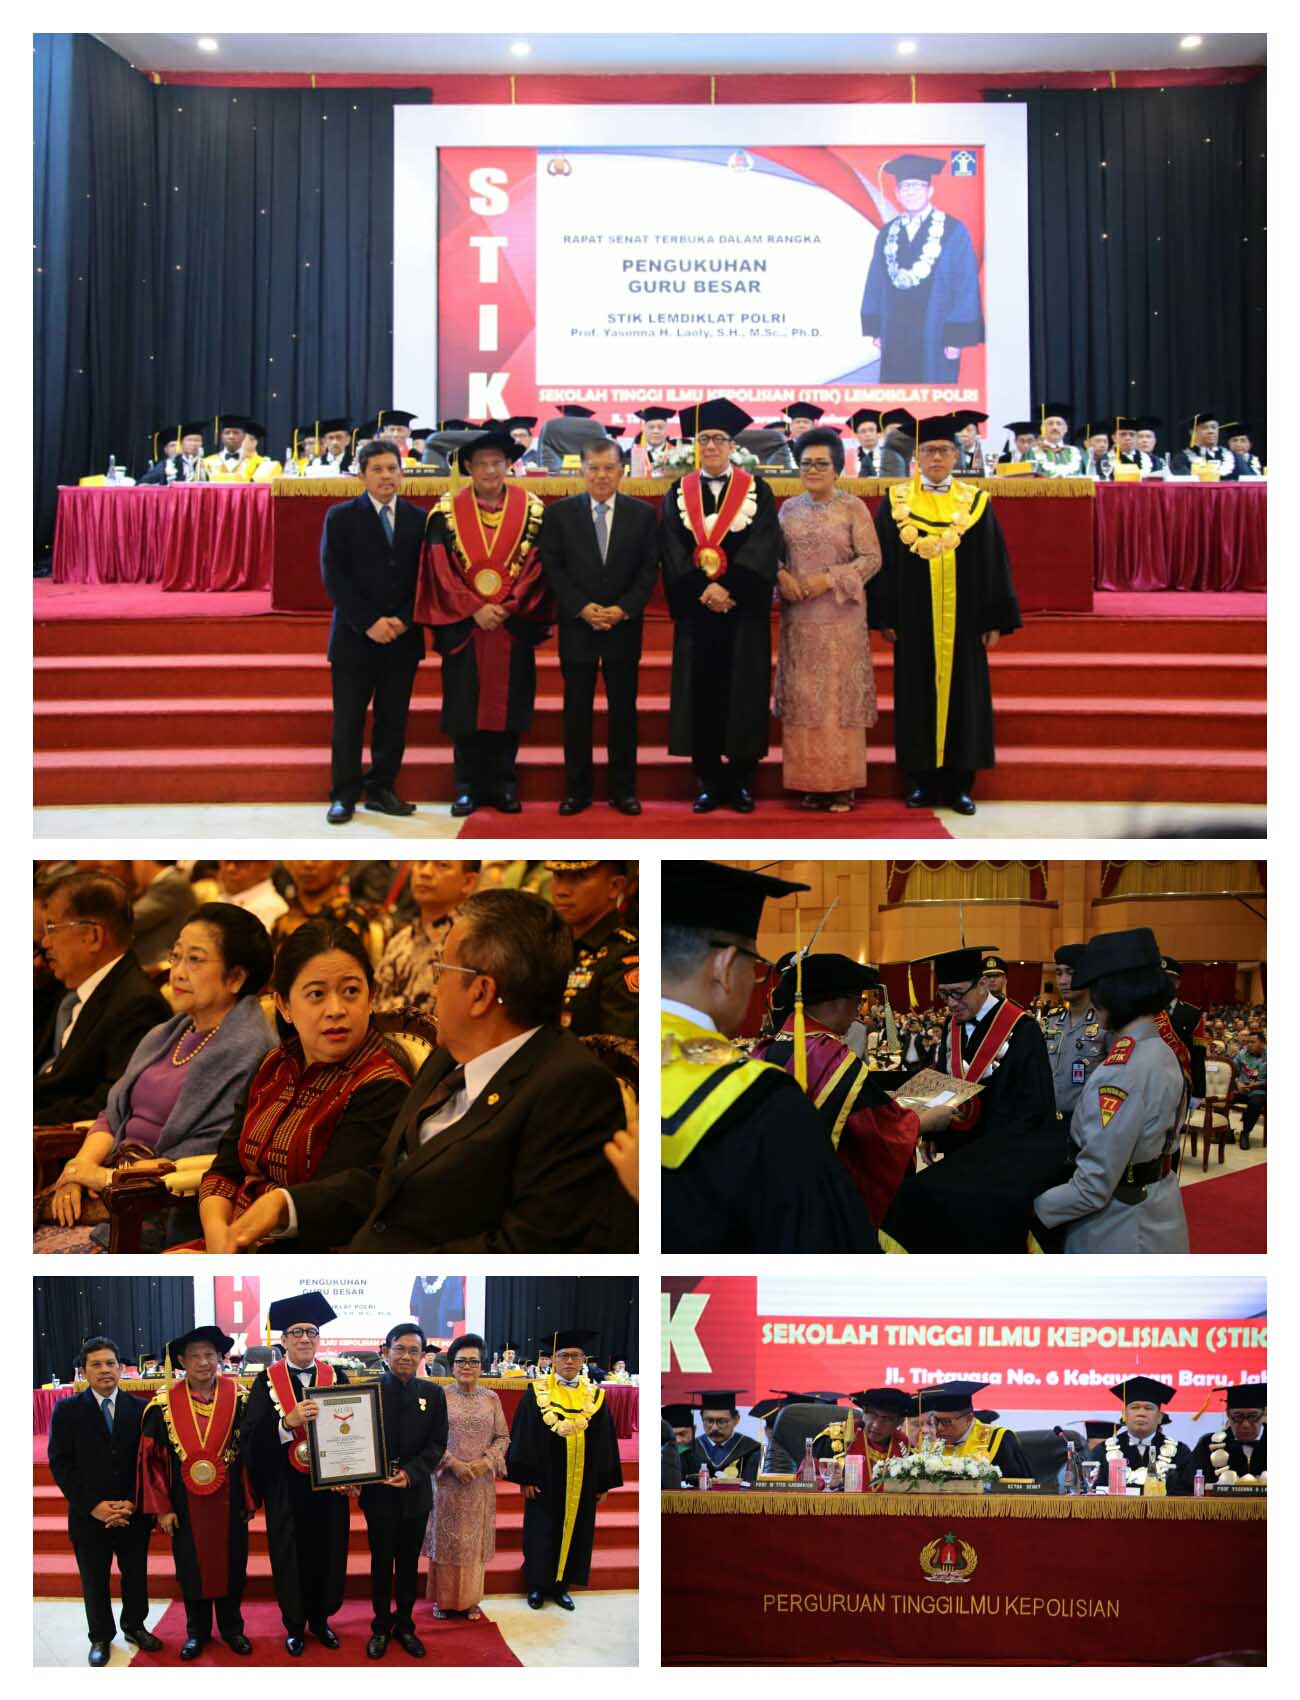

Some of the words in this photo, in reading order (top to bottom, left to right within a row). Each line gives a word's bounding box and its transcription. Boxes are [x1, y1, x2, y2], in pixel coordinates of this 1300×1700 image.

[563, 234, 603, 244] RAPAT
[608, 234, 649, 244] SENAT
[655, 234, 715, 244] TERBUKA
[719, 234, 763, 244] DALAM
[767, 234, 822, 244] RANGKA
[622, 258, 768, 273] PENGUKUHAN
[468, 167, 511, 420] STIK
[628, 279, 686, 294] GURU
[693, 279, 762, 294] BESAR
[607, 312, 643, 324] STIK
[648, 312, 736, 324] LEMDIKLAT
[740, 312, 787, 324] POLRI
[570, 328, 599, 338] Prof.
[659, 328, 673, 338] H.
[791, 328, 823, 338] Ph.D.
[538, 388, 608, 402] SEKOLAH
[611, 388, 663, 402] TINGGI
[666, 388, 703, 402] ILMU
[706, 388, 794, 402] KEPOLISIAN
[845, 388, 928, 402] LEMDIKLAT
[931, 388, 979, 402] POLRI
[1103, 1097, 1118, 1110] 77
[761, 1322, 879, 1345] SEKOLAH
[884, 1324, 972, 1347] TINGGI
[978, 1325, 1041, 1348] ILMU
[1047, 1326, 1199, 1349] KEPOLISIAN
[885, 1367, 905, 1385] Jl.
[1006, 1368, 1042, 1386] No.
[1046, 1370, 1060, 1386] 6
[1178, 1369, 1234, 1388] Baru,
[763, 1593, 886, 1614] PERGURUAN
[1005, 1595, 1120, 1618] KEPOLISIAN
